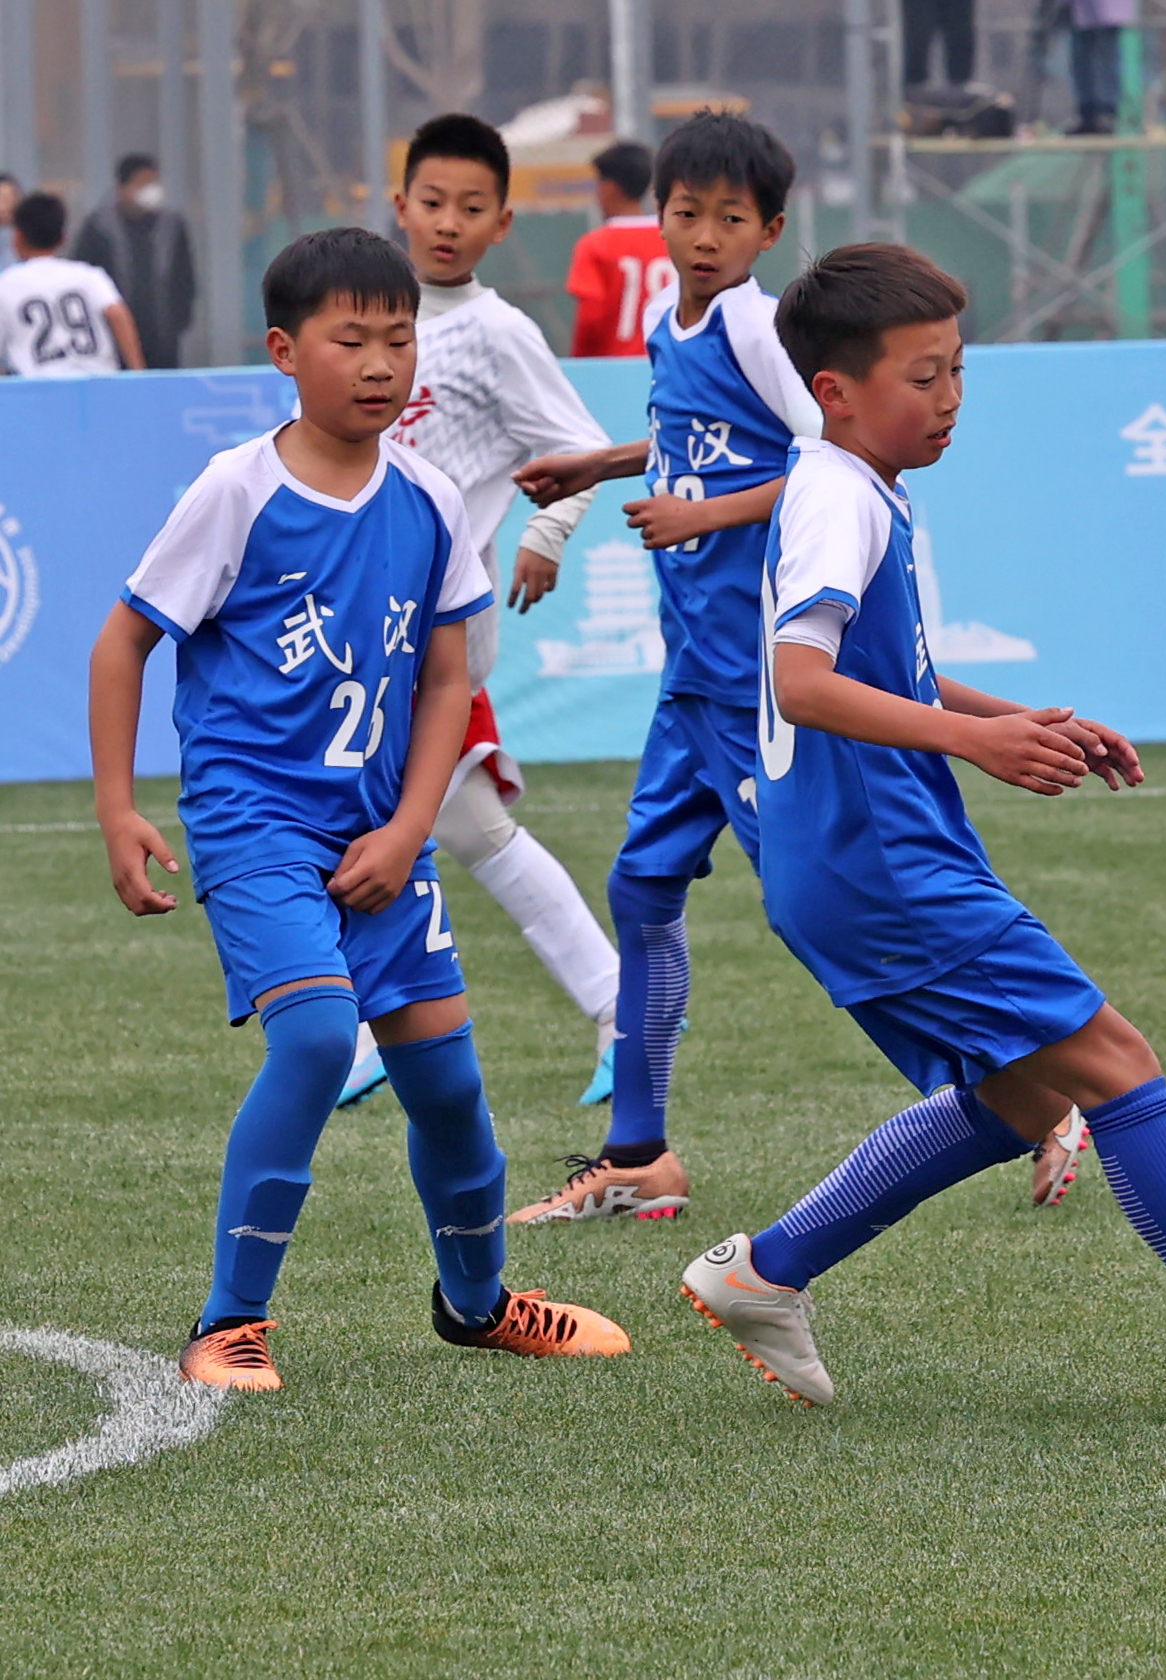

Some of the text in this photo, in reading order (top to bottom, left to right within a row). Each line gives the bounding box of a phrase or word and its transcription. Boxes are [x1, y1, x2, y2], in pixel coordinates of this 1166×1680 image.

[20, 290, 99, 365] 29
[276, 593, 418, 675] 武汉
[323, 676, 391, 768] 26
